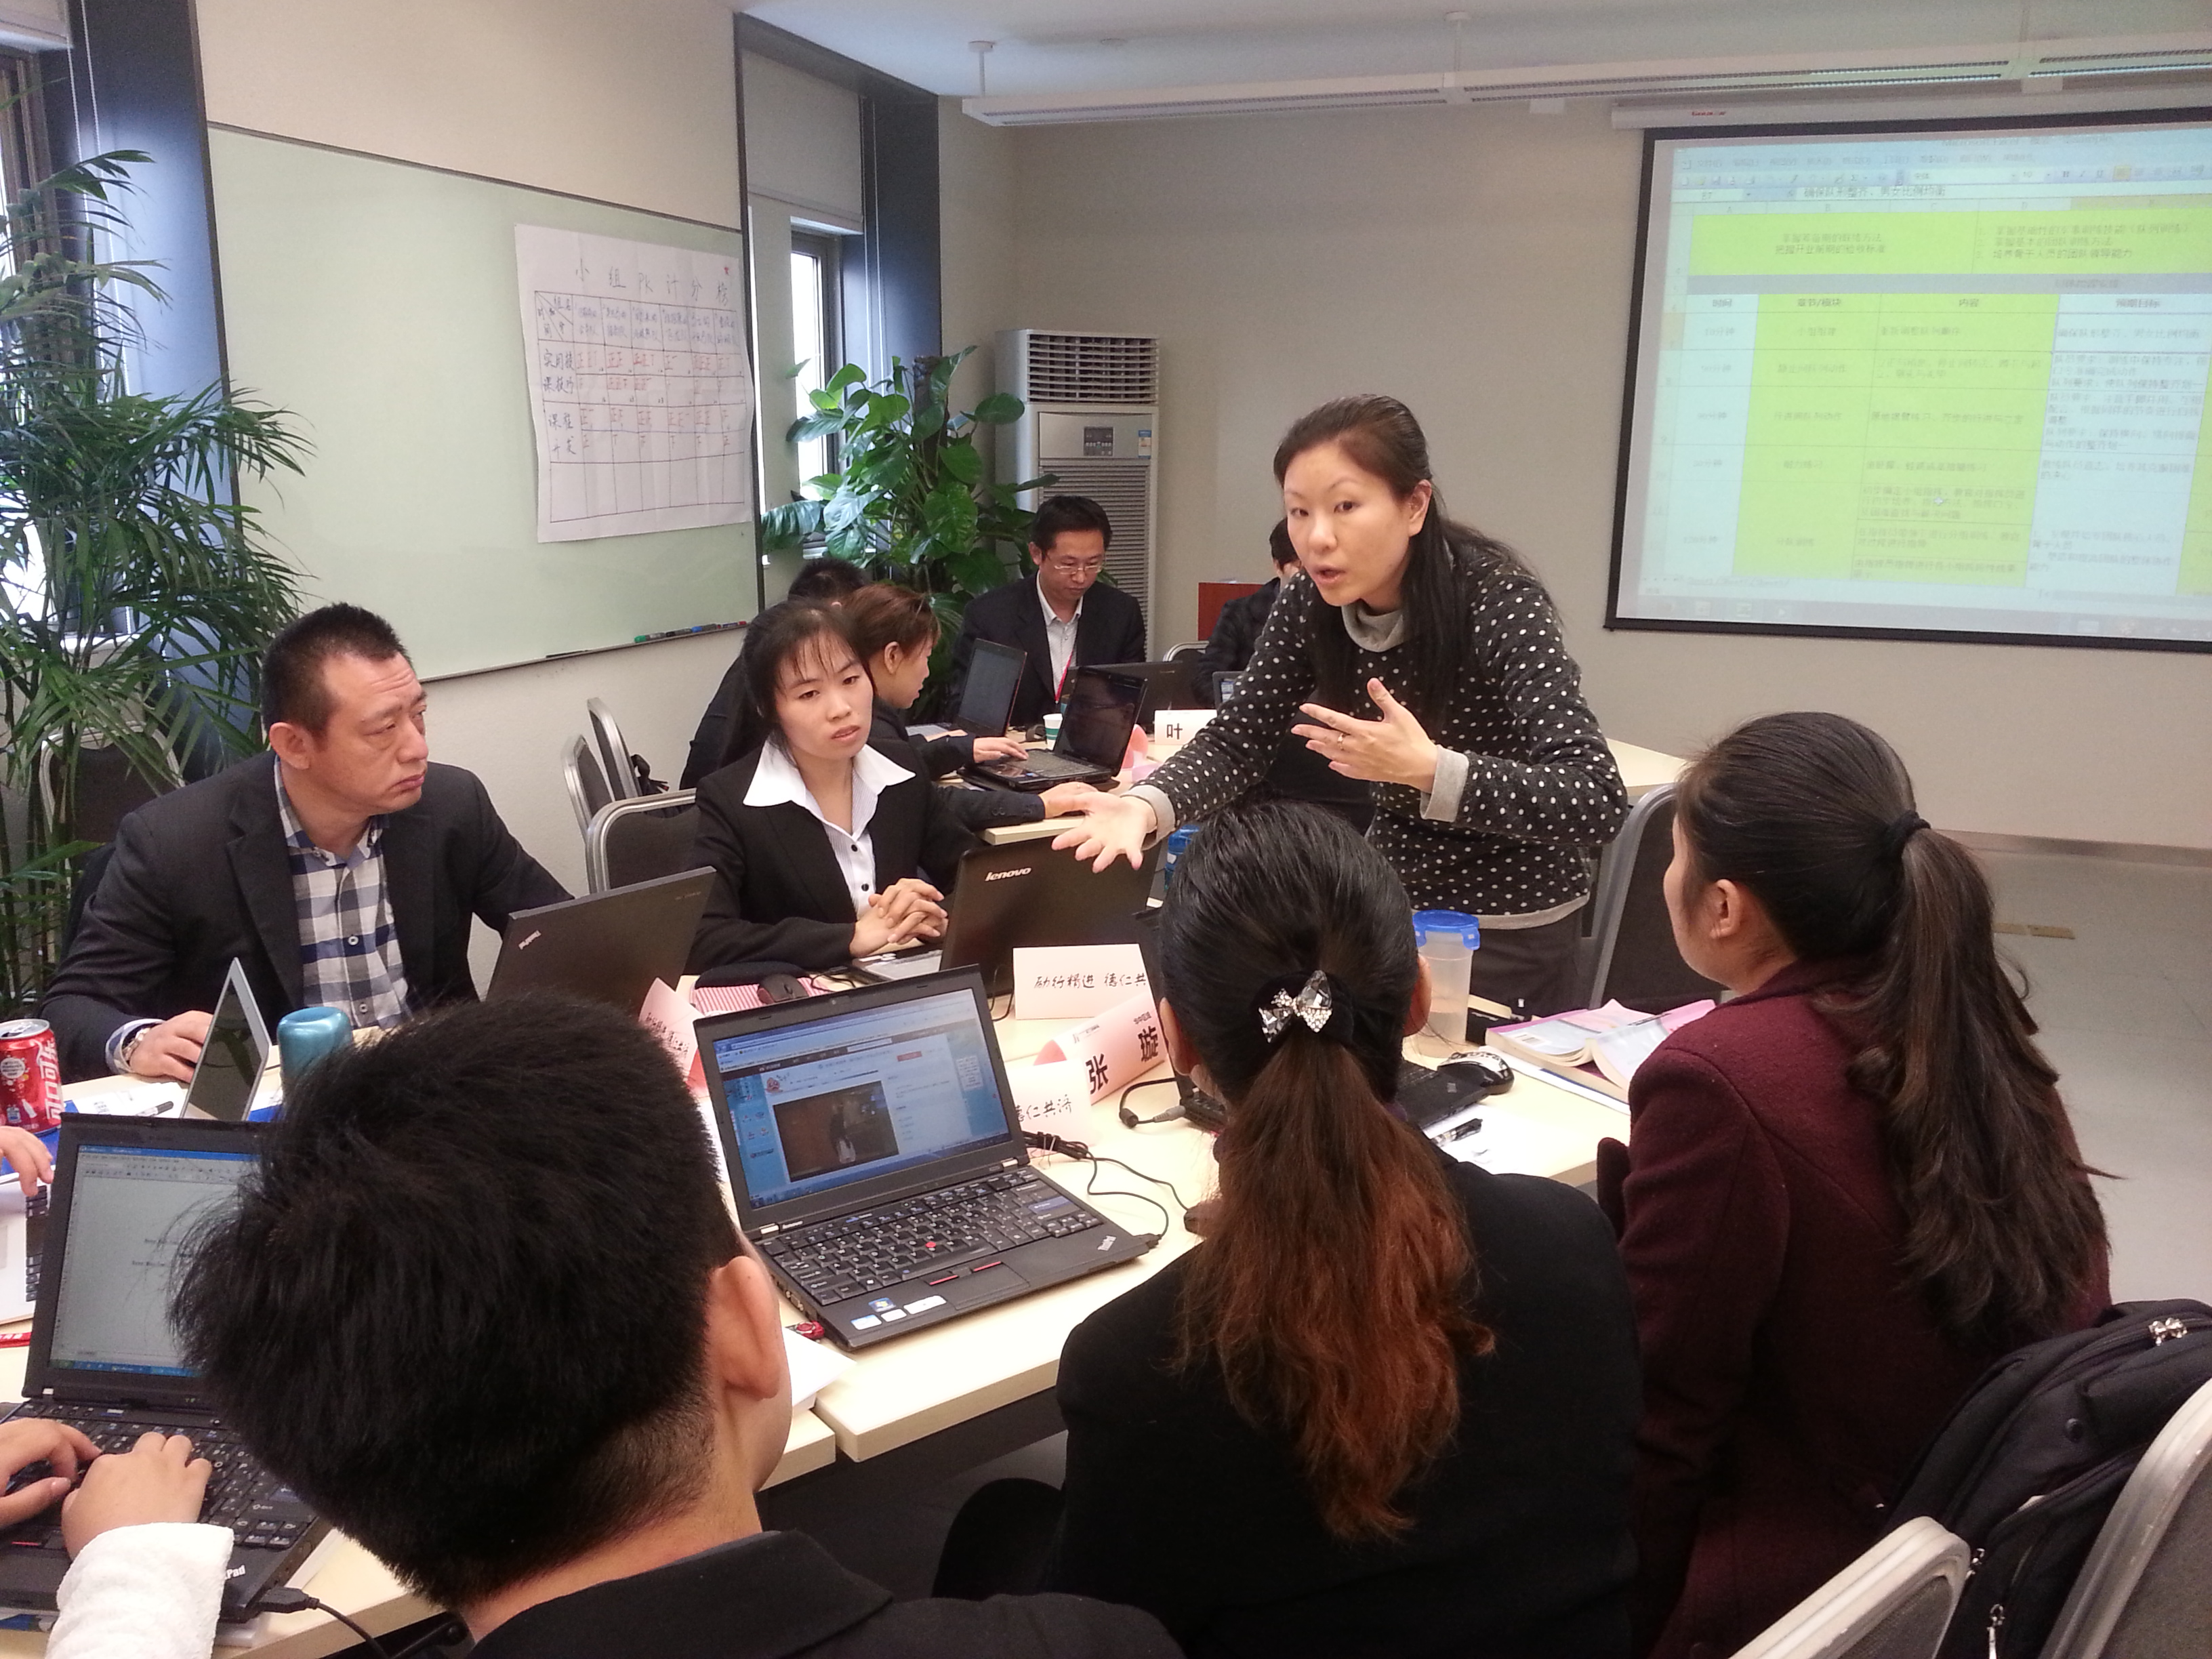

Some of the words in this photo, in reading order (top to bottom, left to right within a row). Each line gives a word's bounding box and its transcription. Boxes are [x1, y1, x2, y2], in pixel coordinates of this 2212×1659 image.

[1166, 722, 1183, 740] 叶
[985, 867, 1032, 882] lenovo
[1085, 1054, 1109, 1094] 张
